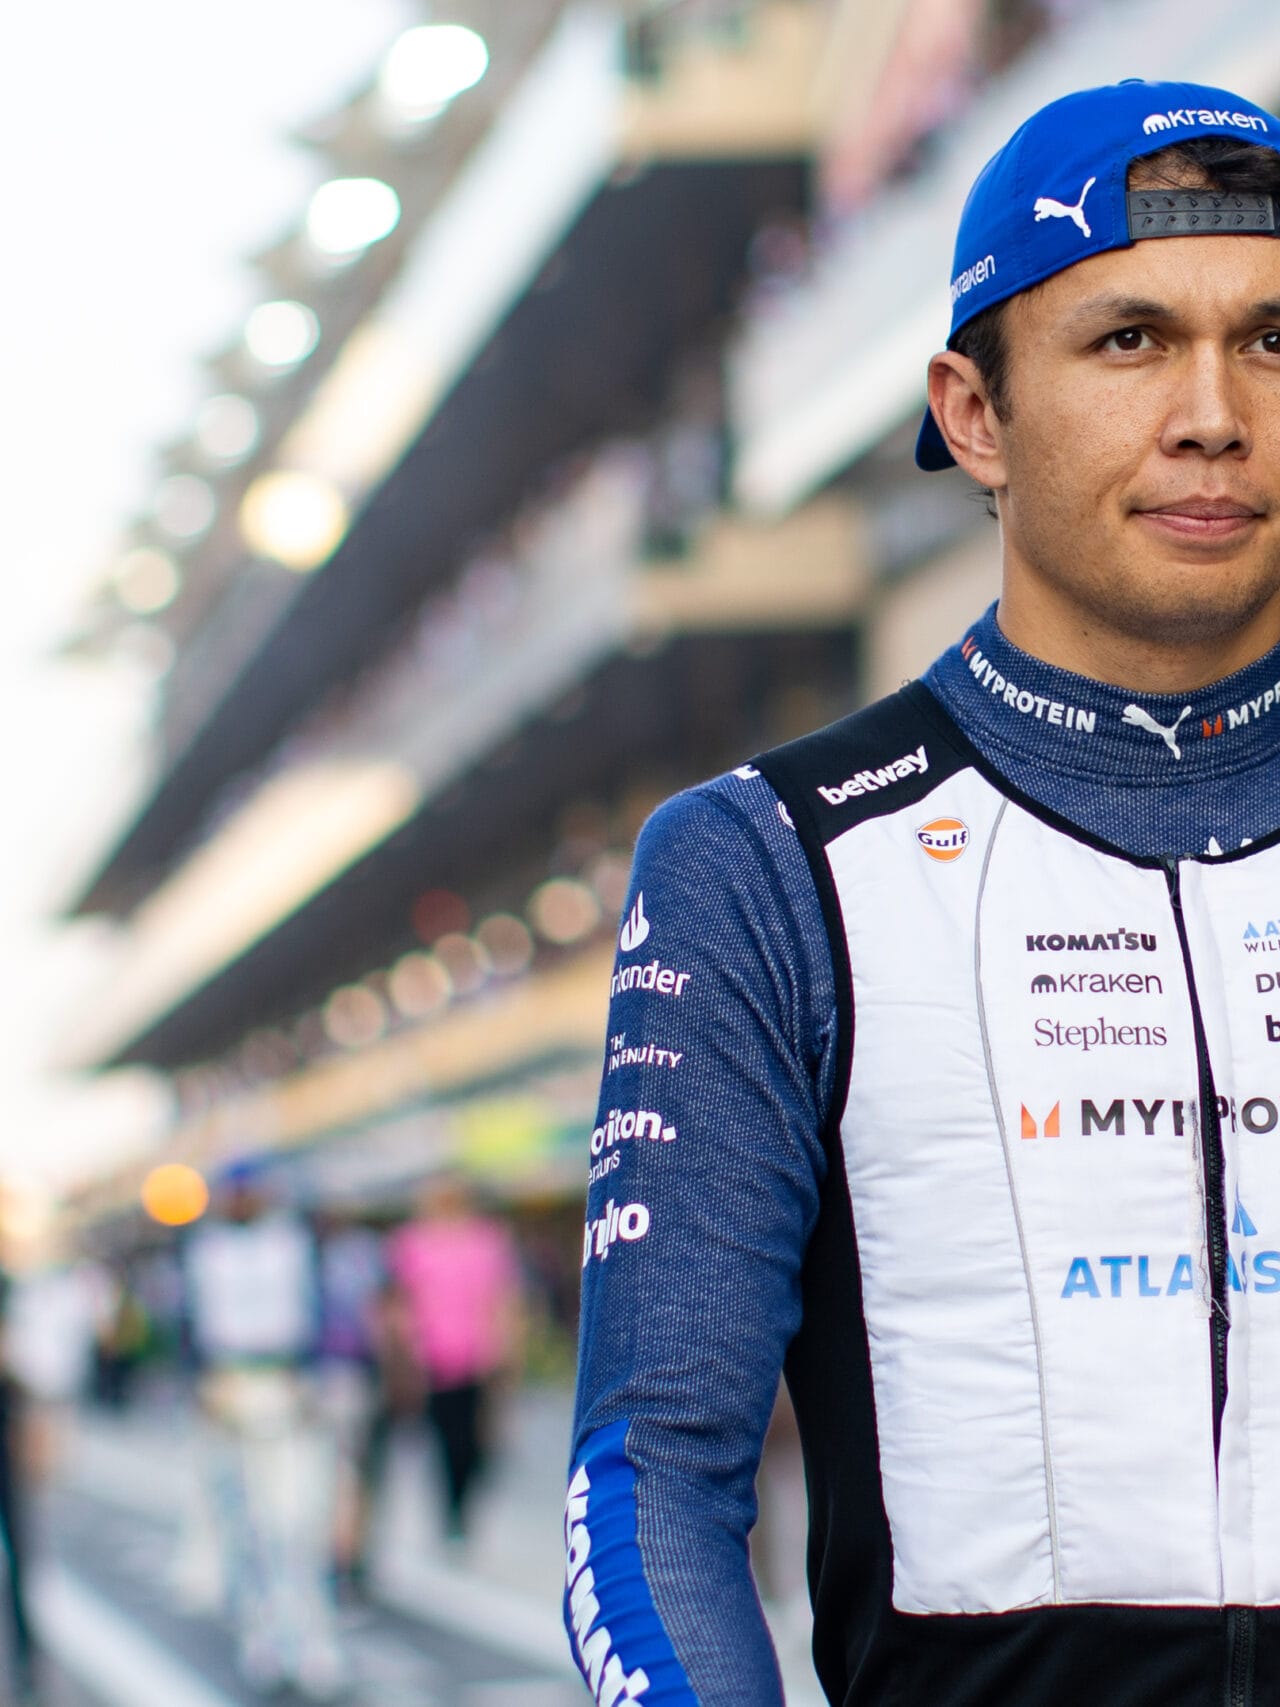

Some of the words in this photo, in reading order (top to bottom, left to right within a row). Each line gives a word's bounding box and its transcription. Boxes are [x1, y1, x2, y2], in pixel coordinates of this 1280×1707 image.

[969, 651, 1097, 733] MYPROTEIN
[817, 745, 929, 805] betway
[917, 831, 967, 847] Gulf
[1026, 928, 1157, 951] KOMATSU
[1034, 1016, 1167, 1051] Stephens
